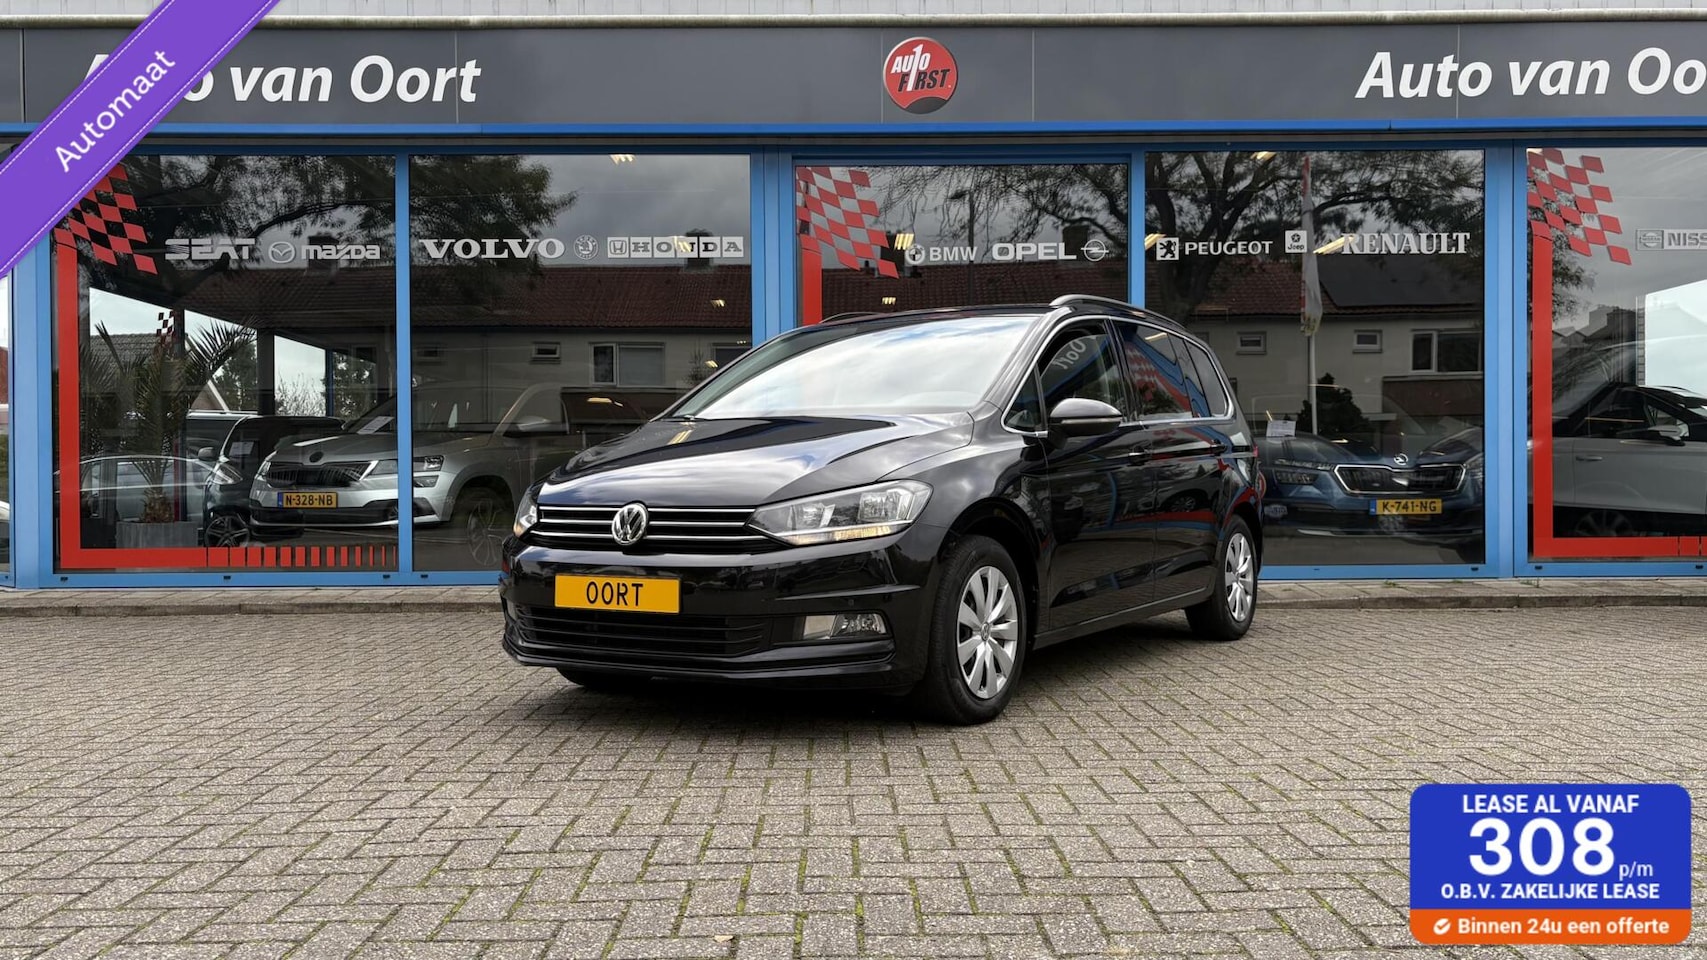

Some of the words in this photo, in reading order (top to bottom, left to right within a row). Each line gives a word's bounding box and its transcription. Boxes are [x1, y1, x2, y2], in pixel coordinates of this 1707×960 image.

[230, 65, 333, 102] van
[350, 54, 482, 102] Oort
[1355, 51, 1493, 99] Auto
[1508, 59, 1611, 96] van
[165, 238, 255, 260] SEAT
[301, 244, 381, 260] mazda
[419, 238, 565, 259] VOLVO
[631, 239, 743, 254] HONDA
[929, 246, 978, 261] BMW
[992, 242, 1077, 260] OPEL
[1184, 240, 1273, 255] PEUGEOT
[1341, 232, 1470, 255] RENAULT
[285, 494, 333, 506] N-328-NB
[1382, 501, 1437, 513] K-741-NG
[586, 581, 644, 607] OORT
